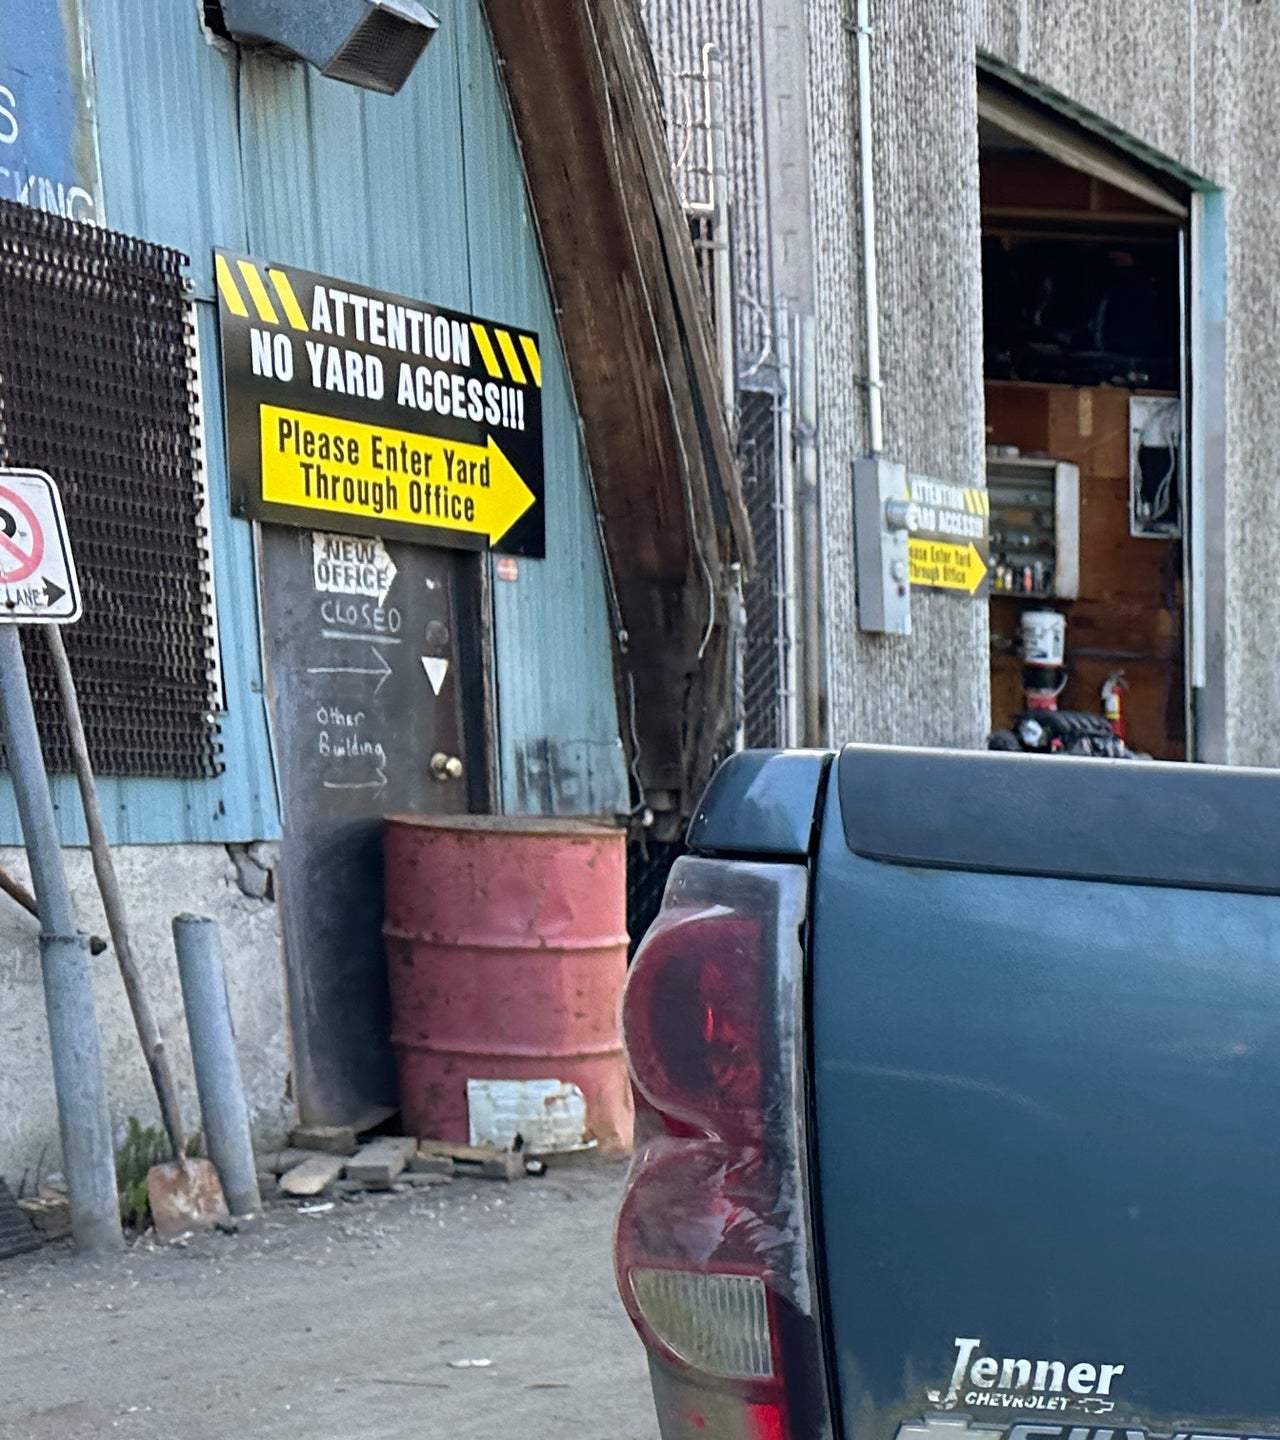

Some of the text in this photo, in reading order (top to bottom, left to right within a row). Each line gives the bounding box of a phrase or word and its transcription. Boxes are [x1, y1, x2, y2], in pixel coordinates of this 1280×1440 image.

[312, 285, 471, 367] ATTENTION
[250, 328, 525, 431] NO YARD ACCESS!!!
[278, 417, 490, 488] Please Enter Yard
[300, 462, 474, 522] Through Office
[325, 540, 375, 564] NEW
[317, 562, 388, 590] OFFICE
[320, 600, 401, 632] CLOSED
[316, 707, 365, 727] Other
[318, 731, 387, 769] Building
[926, 1337, 1125, 1411] Jenner
[964, 1391, 1069, 1412] CHEVROLET
